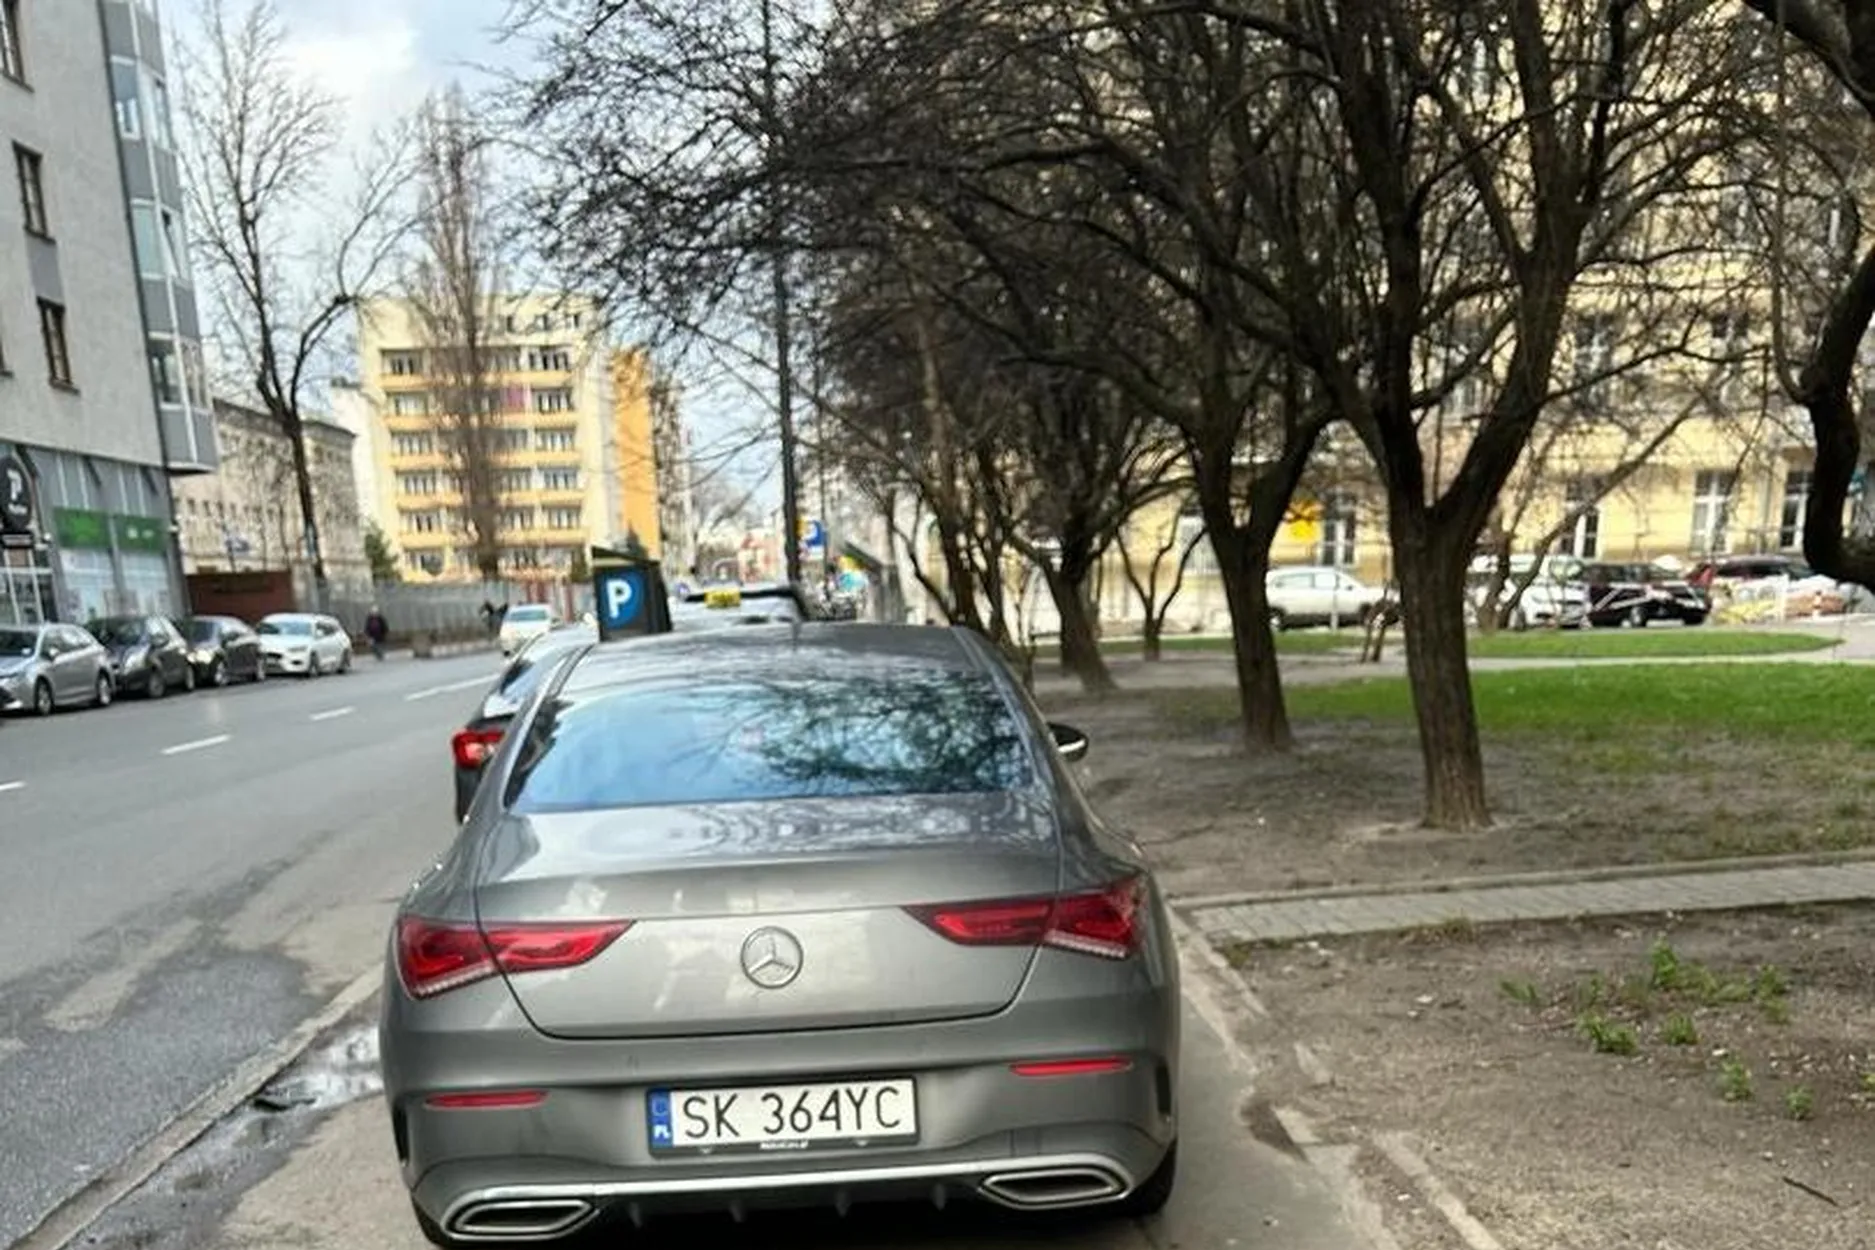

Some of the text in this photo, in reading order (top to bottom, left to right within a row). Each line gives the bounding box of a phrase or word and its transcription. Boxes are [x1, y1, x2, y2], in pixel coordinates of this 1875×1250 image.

[607, 579, 632, 618] P
[682, 1087, 901, 1139] SK 364YC
